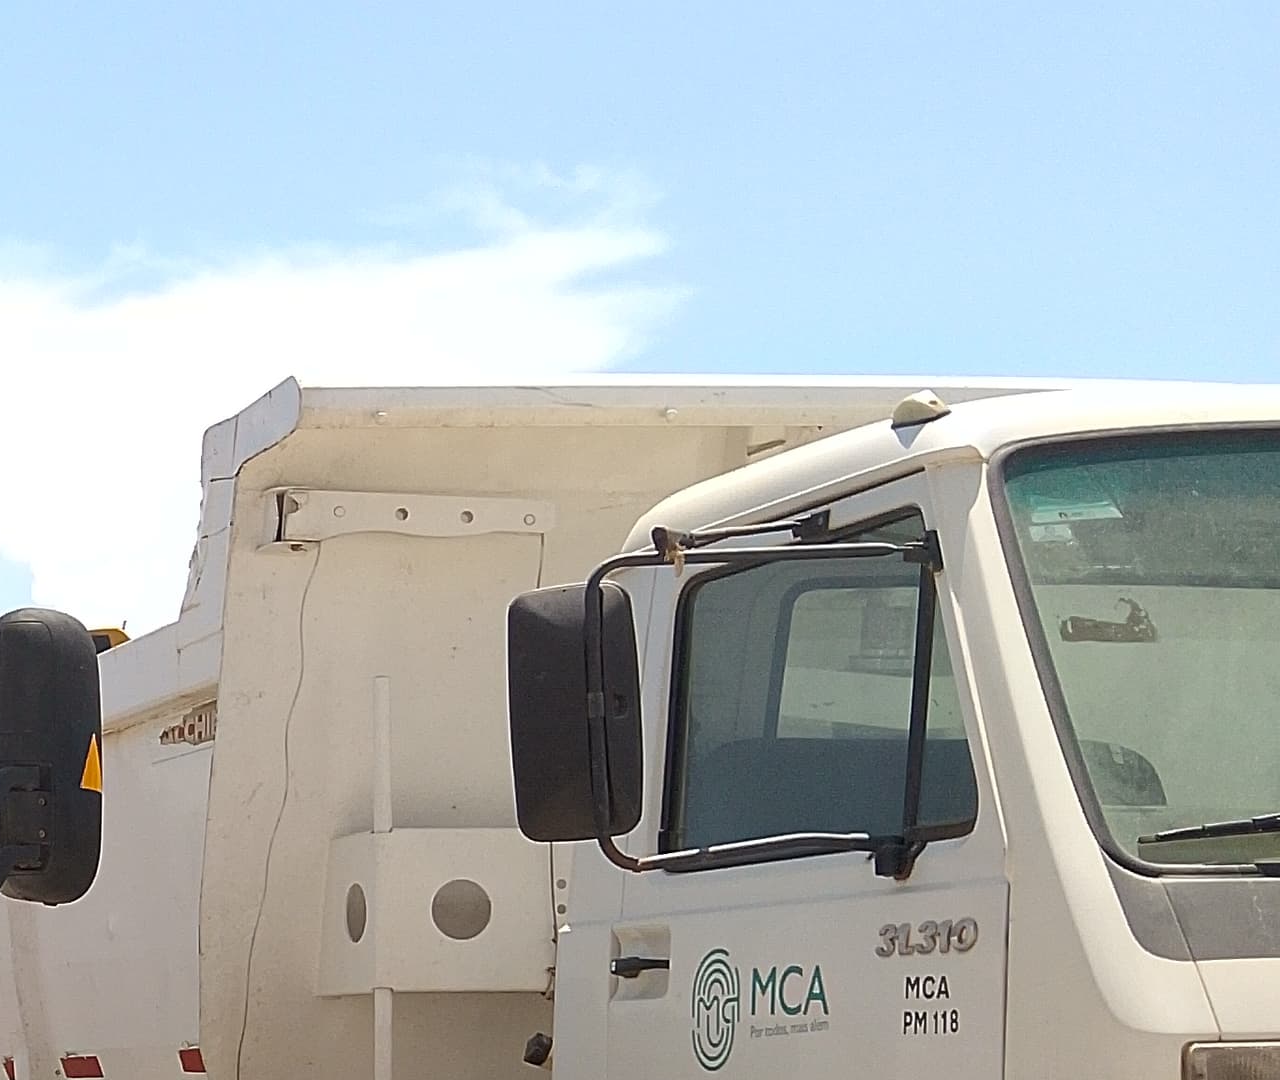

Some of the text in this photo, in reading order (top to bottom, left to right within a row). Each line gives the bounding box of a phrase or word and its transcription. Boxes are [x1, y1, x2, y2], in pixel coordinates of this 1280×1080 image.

[751, 965, 829, 1016] MCA
[905, 975, 950, 999] MCA
[903, 1009, 959, 1035] PM 118
